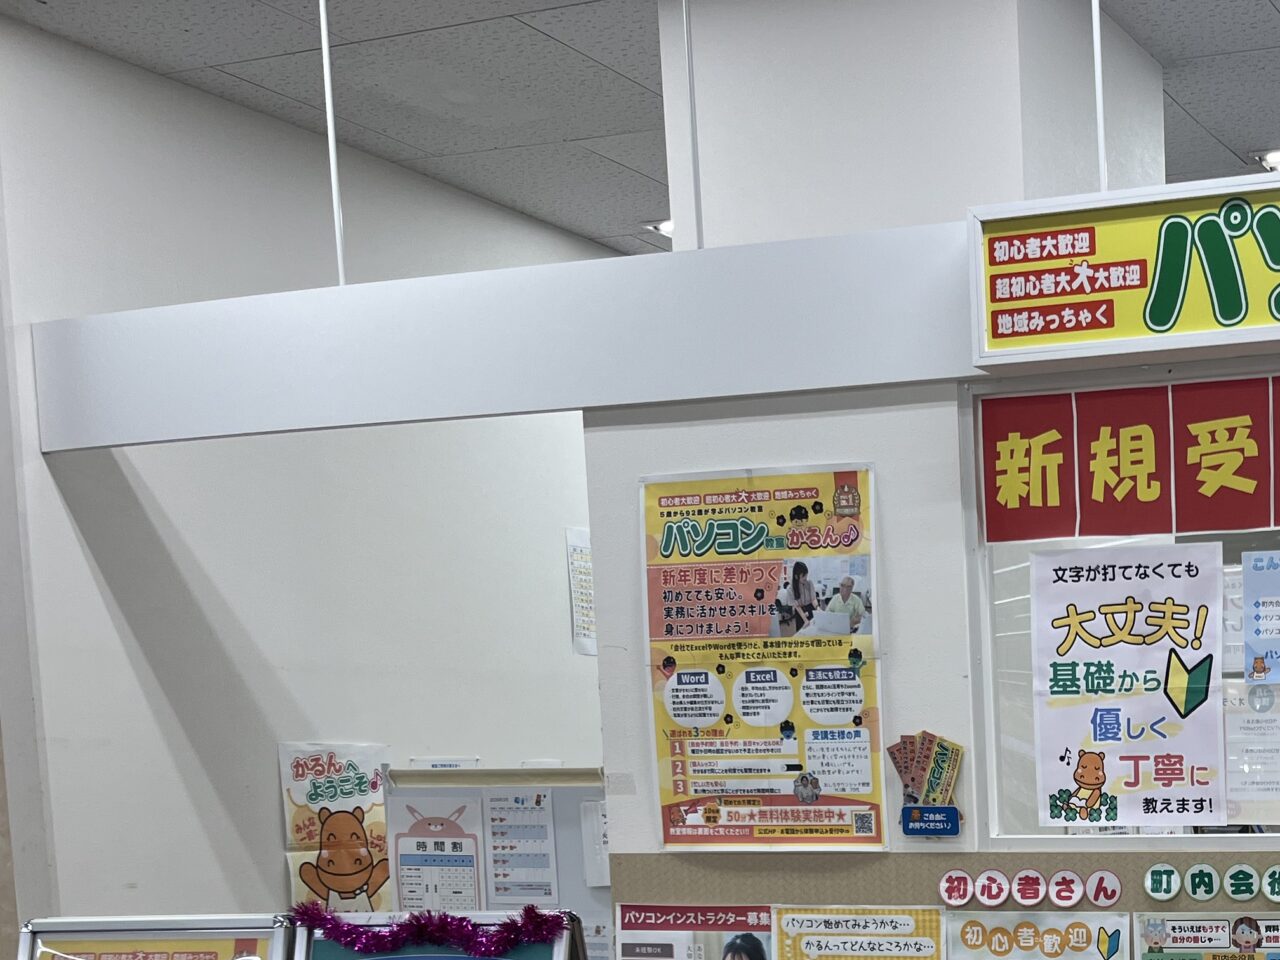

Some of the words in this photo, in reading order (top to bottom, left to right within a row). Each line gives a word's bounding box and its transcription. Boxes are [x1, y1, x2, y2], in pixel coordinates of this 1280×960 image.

[994, 232, 1090, 262] 初心者大歓迎
[997, 304, 1107, 334] 地域みっちゃく
[1053, 561, 1199, 583] 文字が打てなくても
[1051, 596, 1208, 656] 大丈夫!
[681, 674, 705, 683] Word
[750, 673, 774, 682] Excel
[1049, 661, 1162, 696] 基礎から
[812, 731, 861, 740] 受講生様の声
[1091, 708, 1167, 742] 優しく
[292, 752, 359, 781] かるんへ
[1119, 753, 1210, 788] 丁寧に
[1143, 797, 1213, 814] 教えます!
[944, 876, 1116, 901] 初心者さん
